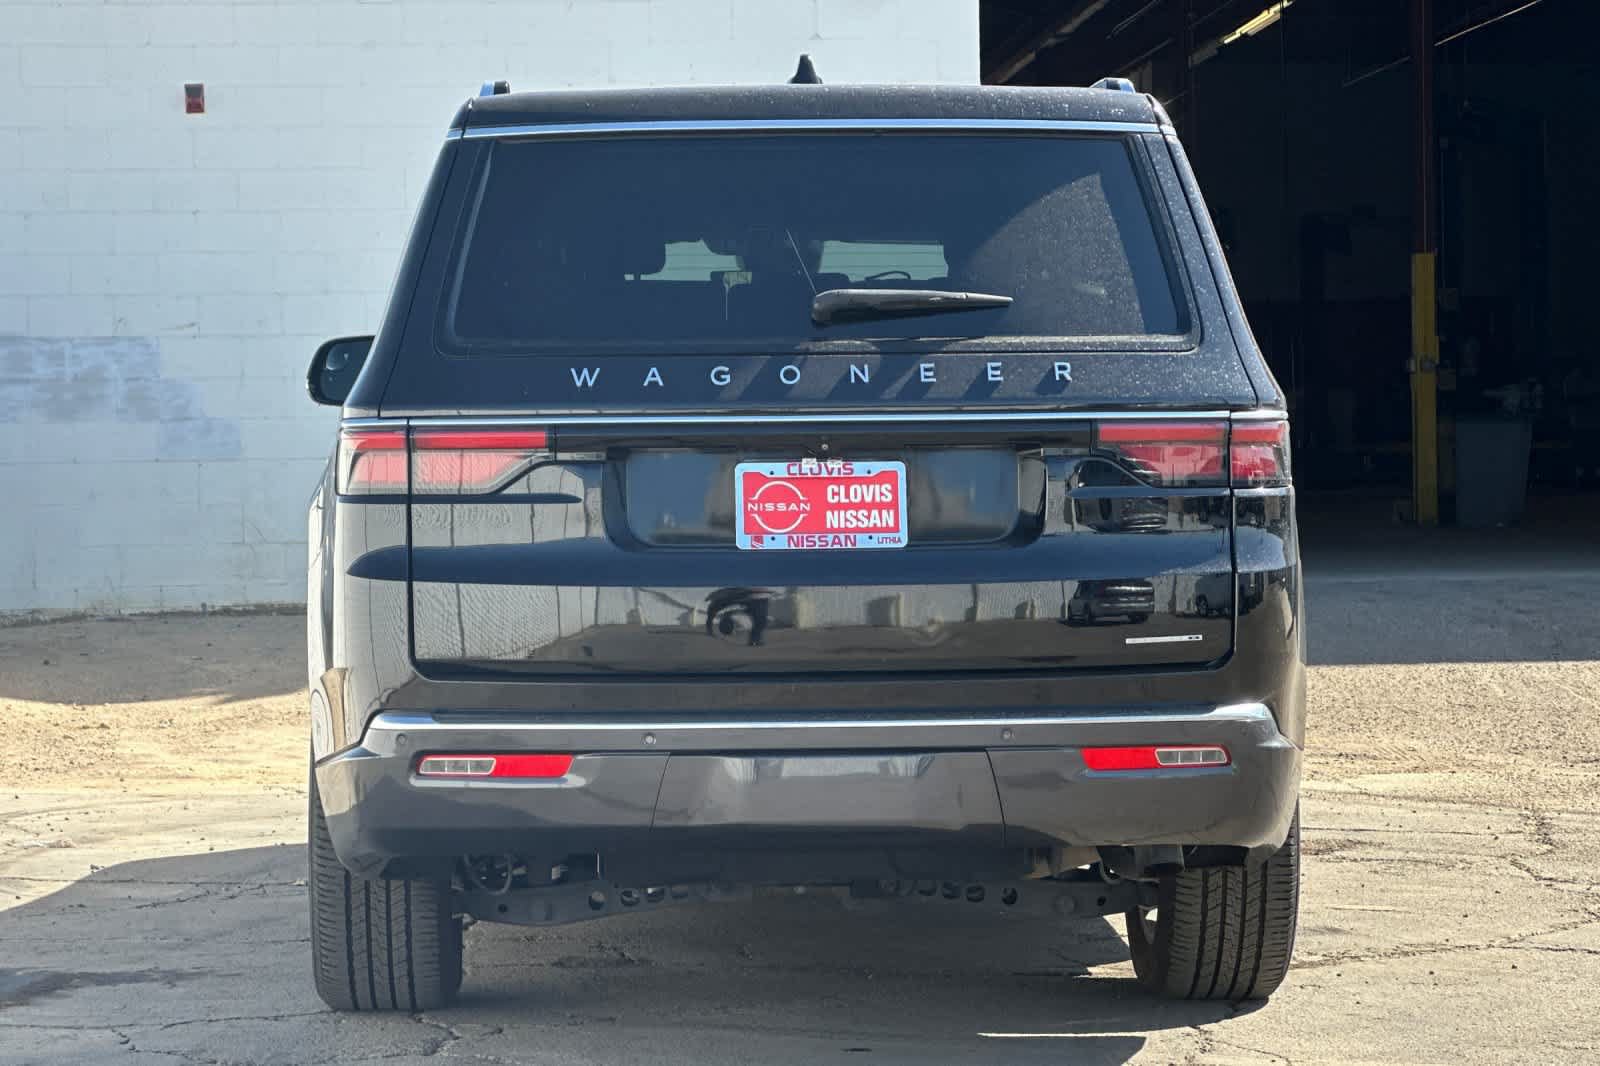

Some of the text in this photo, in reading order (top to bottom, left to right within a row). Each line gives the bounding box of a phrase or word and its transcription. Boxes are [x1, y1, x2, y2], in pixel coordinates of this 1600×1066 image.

[570, 361, 1073, 388] WAGONEER
[786, 462, 855, 476] CLOVIS
[826, 483, 893, 504] CLOVIS
[747, 502, 811, 512] NISSAN
[826, 509, 894, 529] NISSAN
[787, 534, 857, 548] NISSAN
